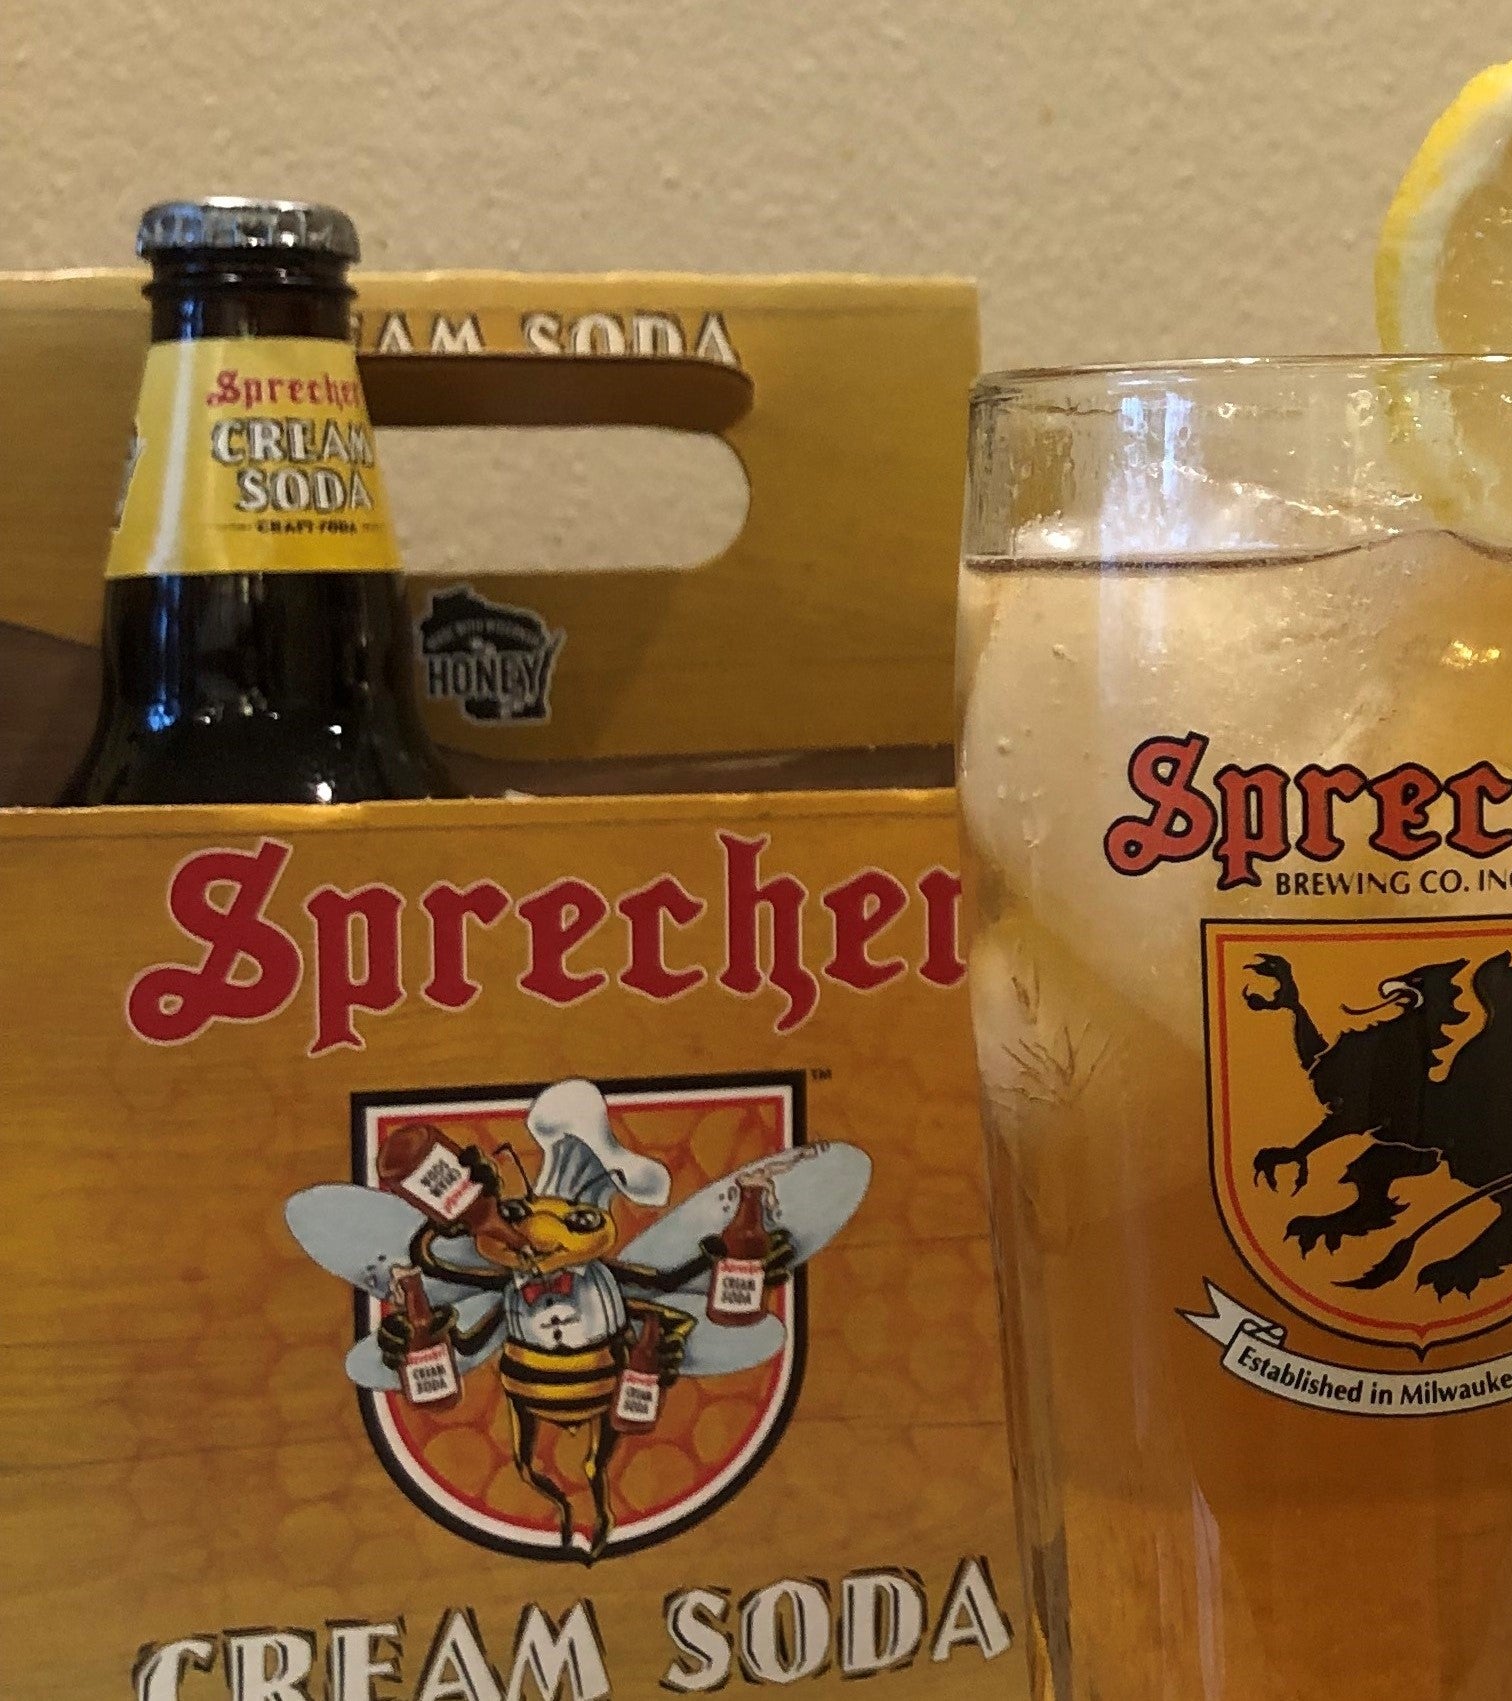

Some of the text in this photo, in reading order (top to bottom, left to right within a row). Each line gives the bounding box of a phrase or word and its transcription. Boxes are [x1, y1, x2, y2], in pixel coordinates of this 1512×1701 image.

[211, 416, 376, 468] CREAM
[235, 467, 375, 513] SODA
[1275, 871, 1411, 897] BREWING
[1418, 868, 1470, 894] CO.
[1237, 1346, 1363, 1404] Established
[1370, 1382, 1394, 1406] in
[131, 1553, 1015, 1701] CREAM SODA
